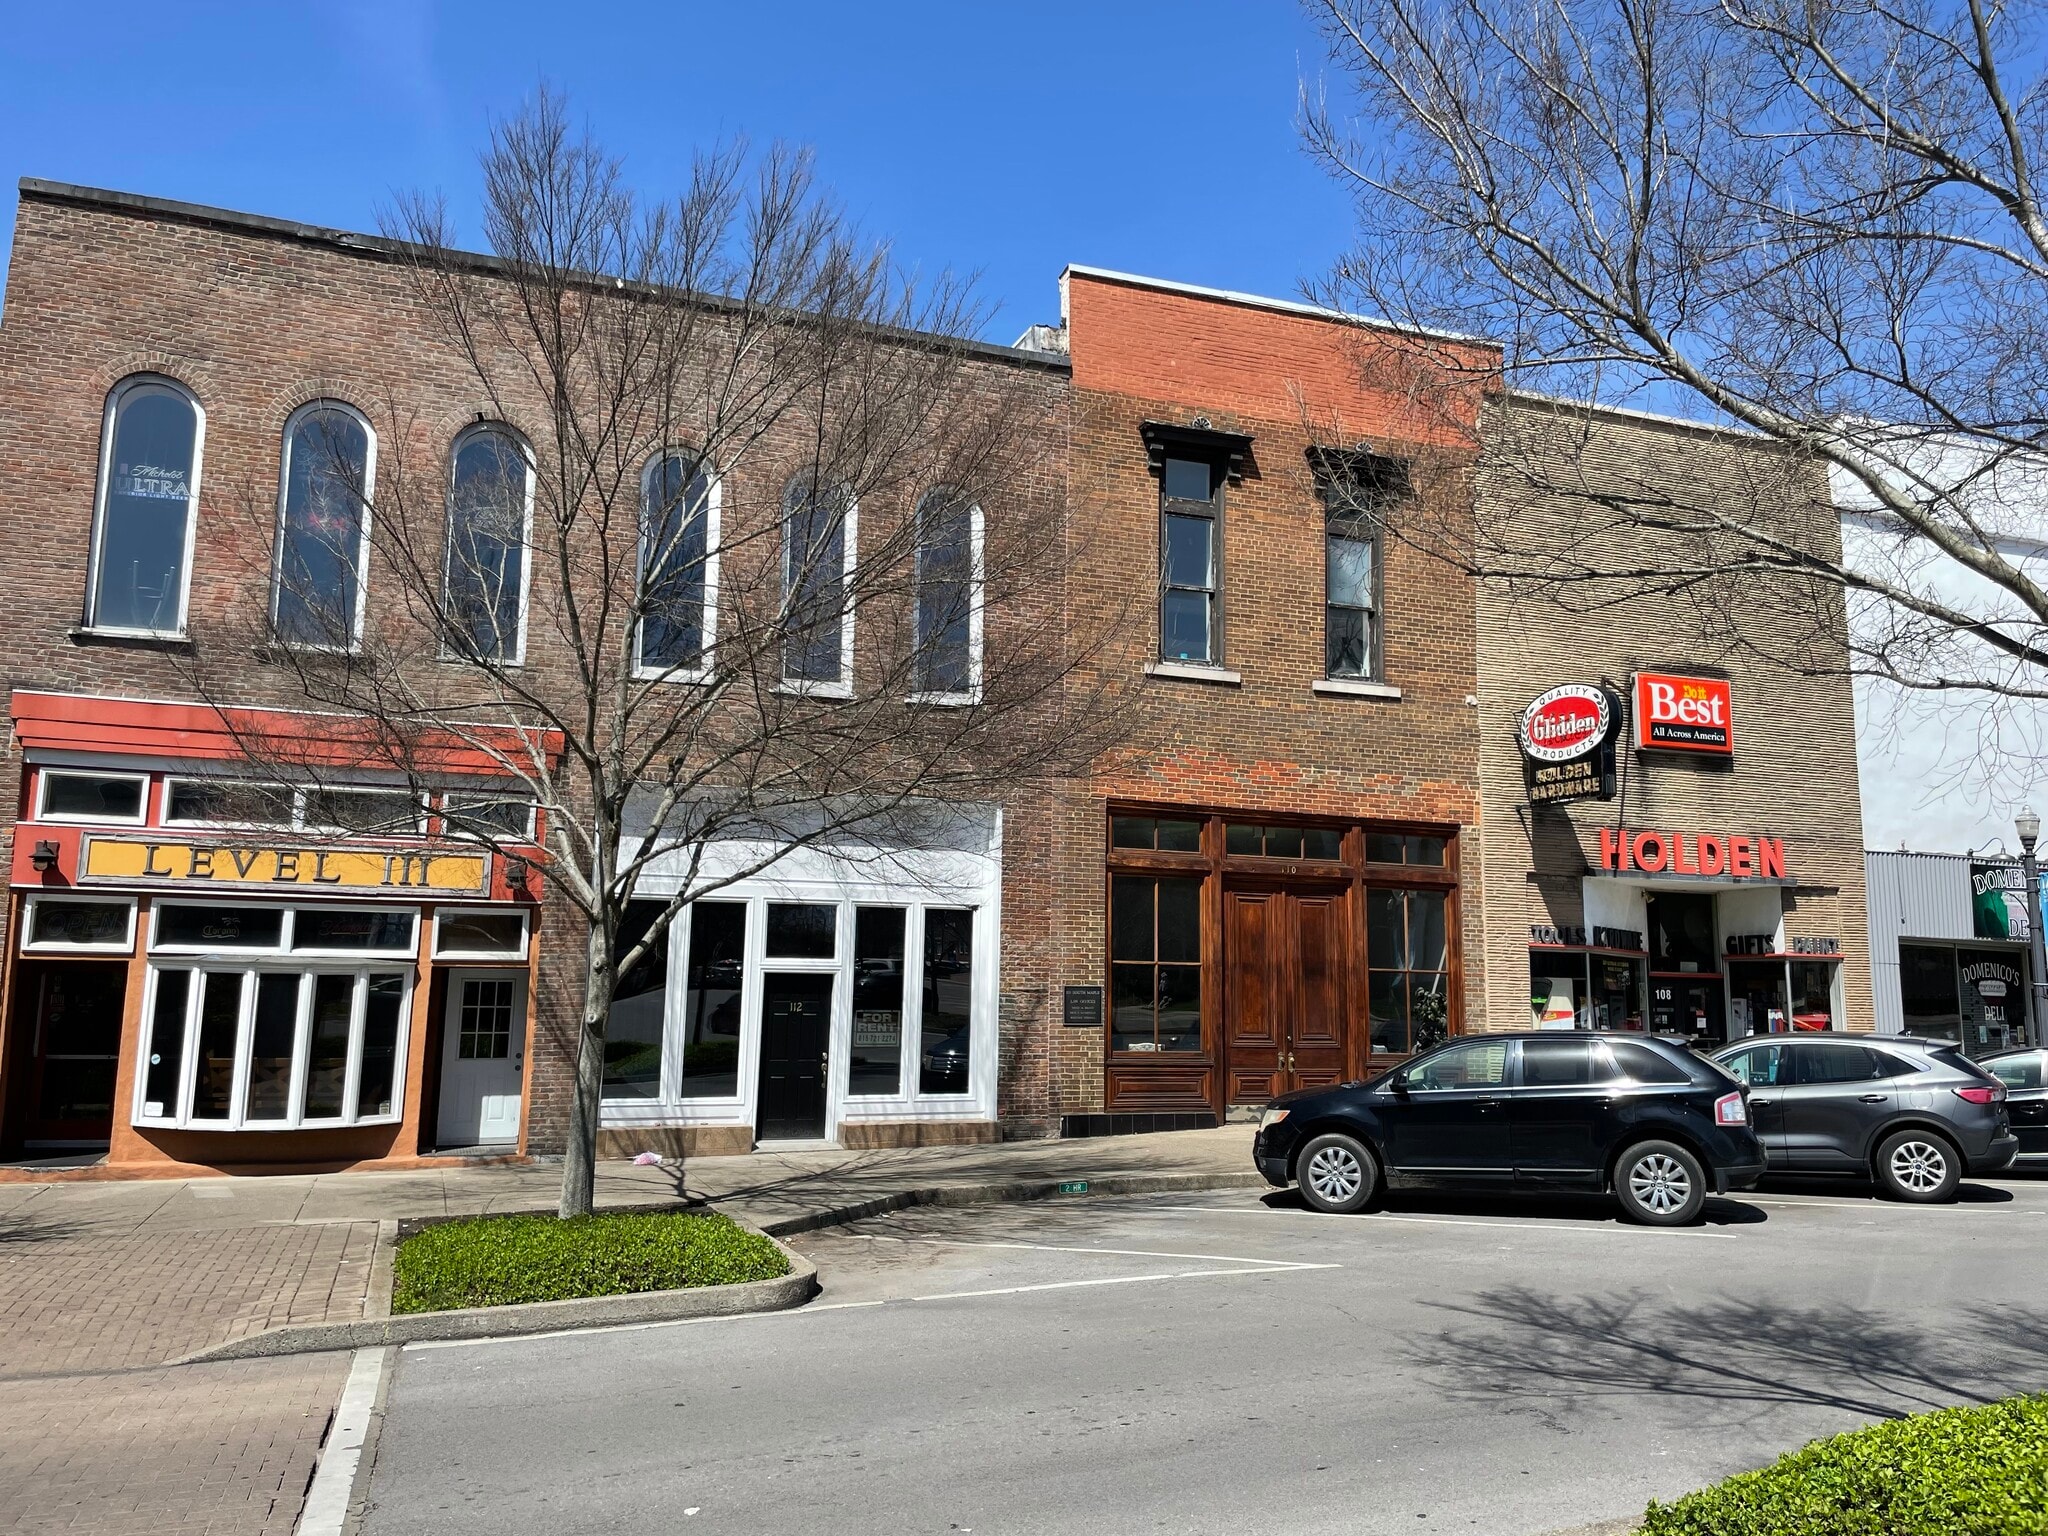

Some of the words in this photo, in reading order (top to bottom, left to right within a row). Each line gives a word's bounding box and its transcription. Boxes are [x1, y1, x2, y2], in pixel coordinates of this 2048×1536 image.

[115, 477, 190, 496] ULTRA
[1539, 687, 1588, 705] QUALITY
[1648, 682, 1725, 725] Best
[1533, 711, 1596, 740] Glidden
[1653, 727, 1665, 736] All
[1667, 728, 1692, 739] Across
[1693, 730, 1725, 742] America
[1535, 739, 1594, 759] PRODUCTS
[1536, 761, 1592, 783] HOLDEN
[1531, 777, 1600, 800] HARDWARE
[1600, 828, 1785, 878] HOLDEN
[142, 845, 341, 883] LEVEL
[380, 854, 431, 886] III
[1531, 925, 1587, 946] TOOLS
[2009, 918, 2031, 937] DE
[1726, 934, 1775, 955] GIFTS
[1792, 936, 1840, 954] PAINT
[1962, 962, 2020, 987] DOMENICO'S
[1655, 989, 1672, 1000] 108
[790, 1002, 803, 1013] 112
[1984, 1006, 2005, 1021] DELI
[863, 1013, 892, 1022] FOR
[858, 1023, 897, 1032] RENT
[1065, 1184, 1070, 1192] 2
[1073, 1183, 1082, 1192] HR
